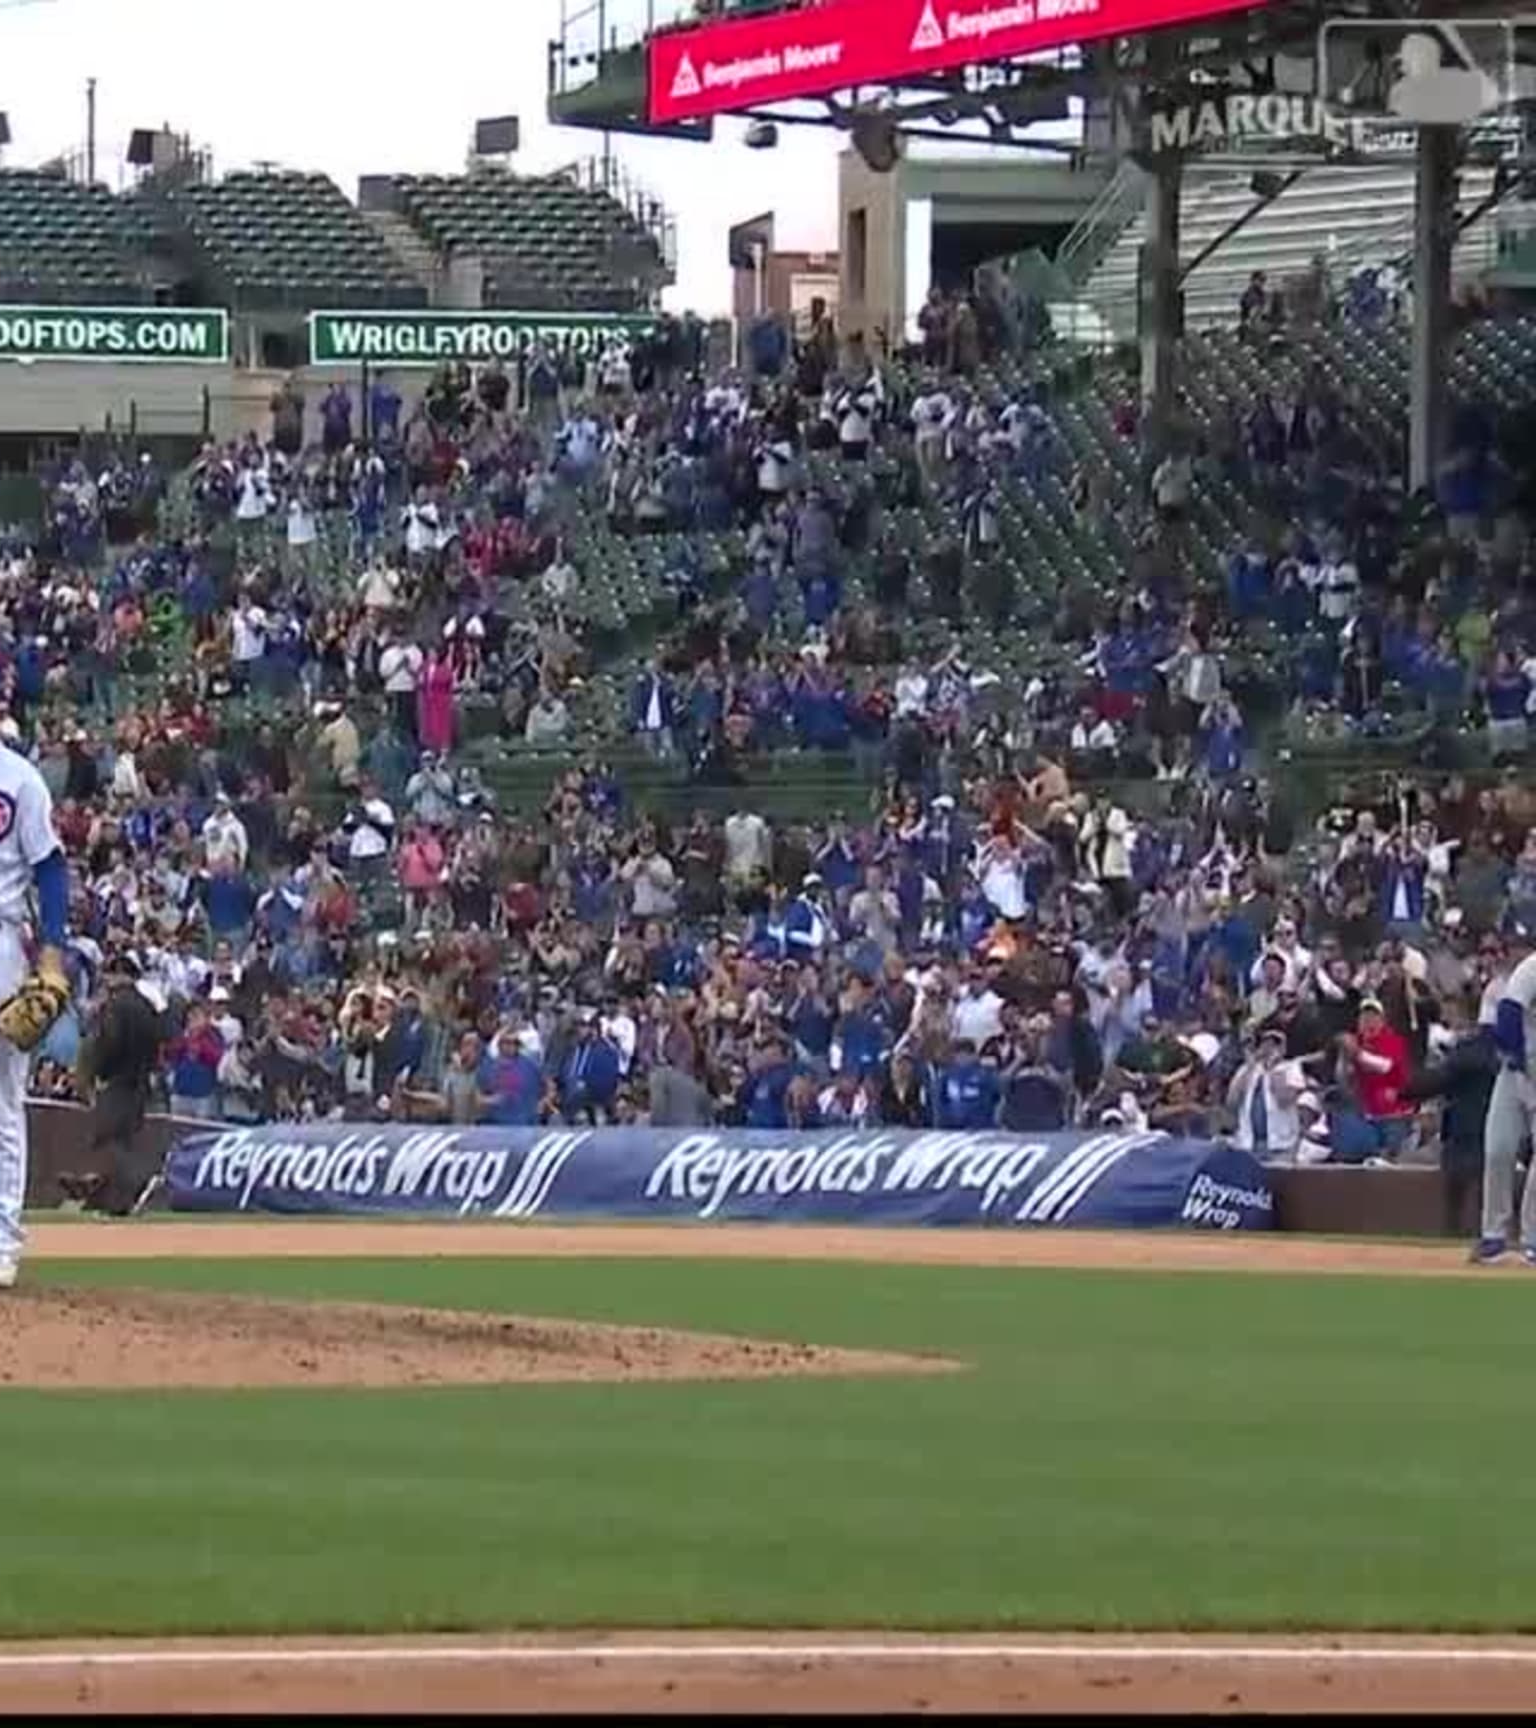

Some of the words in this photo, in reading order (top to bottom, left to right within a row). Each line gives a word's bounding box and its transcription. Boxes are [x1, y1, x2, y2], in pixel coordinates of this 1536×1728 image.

[702, 48, 781, 89] Benjamin
[783, 40, 842, 71] Moore
[195, 1128, 389, 1209] Reynolds
[384, 1132, 508, 1216] Wrap
[645, 1134, 896, 1218] Reynolds
[883, 1131, 1047, 1212] Wrap
[1181, 1195, 1241, 1231] Wrap
